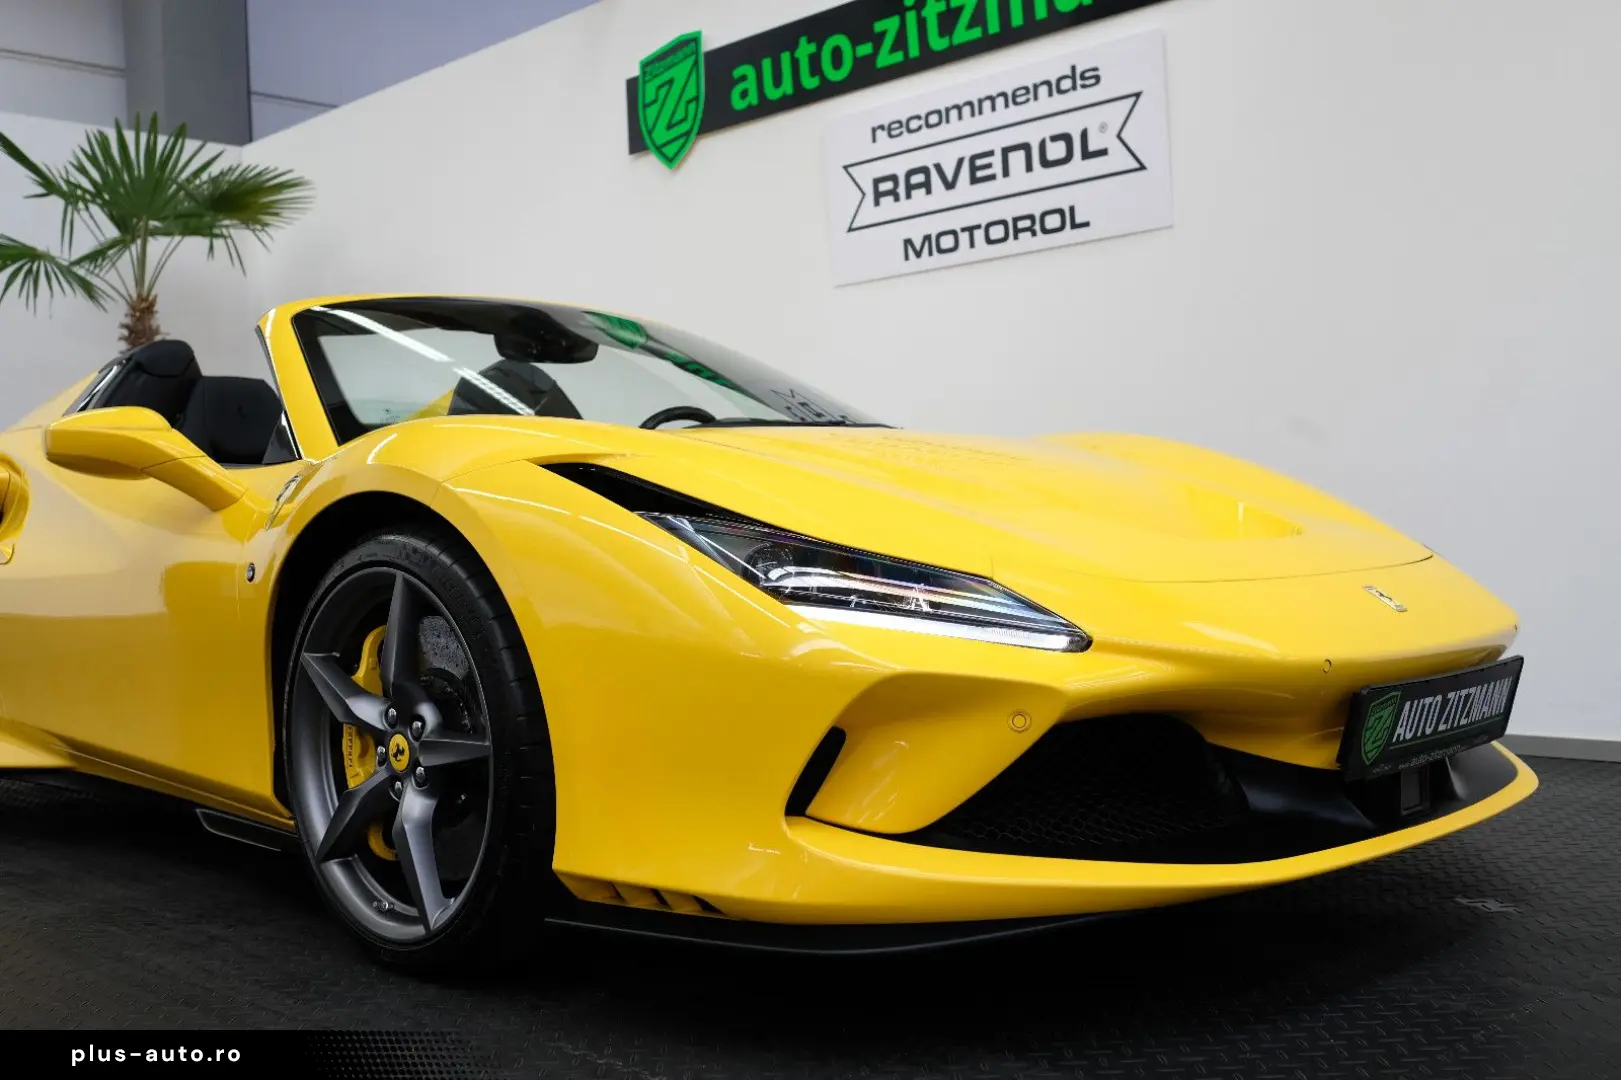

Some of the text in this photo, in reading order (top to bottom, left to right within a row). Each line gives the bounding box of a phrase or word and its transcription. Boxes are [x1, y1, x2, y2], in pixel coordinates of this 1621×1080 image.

[730, 0, 1094, 111] auto-zitzm
[871, 64, 1101, 143] recommends
[872, 127, 1109, 207] RAVENOL
[903, 204, 1090, 261] MOTOROL
[1392, 676, 1512, 743] AUTO ZITZMANN
